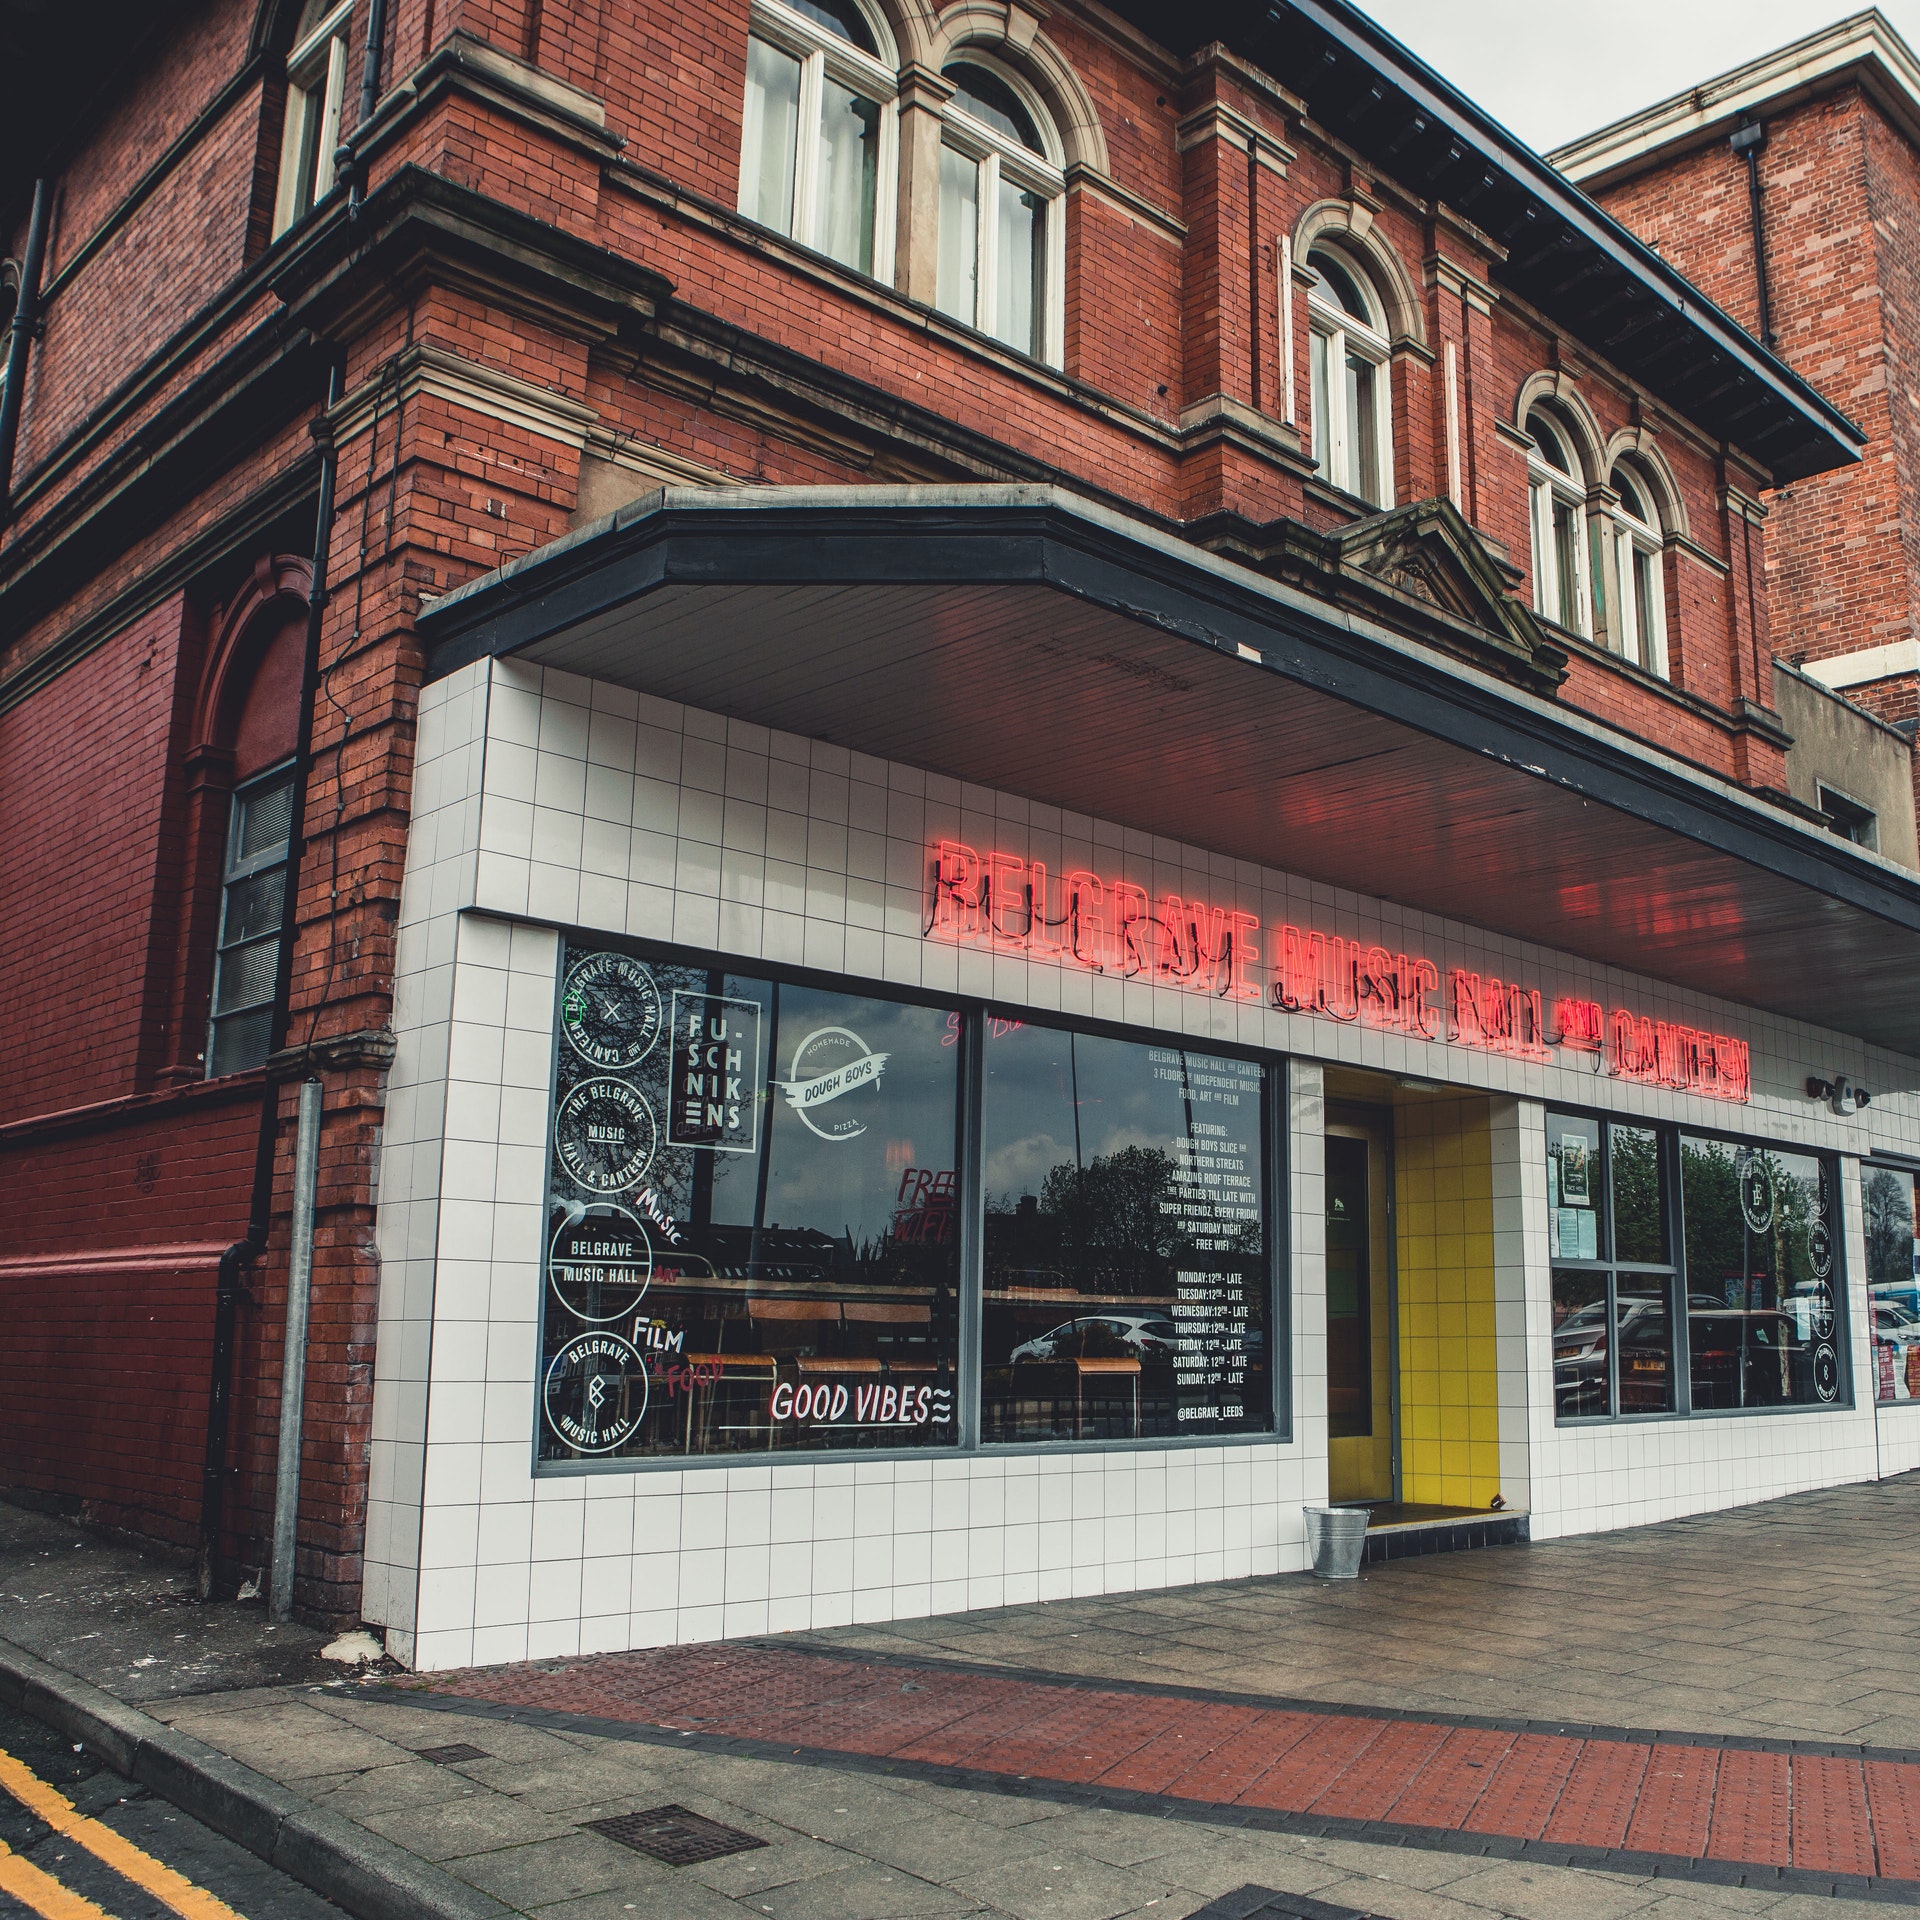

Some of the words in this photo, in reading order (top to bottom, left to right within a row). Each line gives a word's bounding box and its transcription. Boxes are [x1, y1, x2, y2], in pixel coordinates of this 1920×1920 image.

[938, 840, 1261, 998] BELGRAVE
[1282, 925, 1440, 1040] MUSIC
[1456, 969, 1553, 1062] HALL
[1563, 997, 1603, 1041] AND
[1615, 1009, 1751, 1101] CANTEEN
[617, 961, 653, 1000] MUSIC
[640, 1005, 657, 1038] HALL
[569, 1020, 619, 1063] CANTEEN
[628, 1043, 641, 1057] AND
[807, 1038, 851, 1057] HOMEMADE
[1148, 1050, 1184, 1066] BELGRAVE
[1184, 1056, 1209, 1070] MUSIC
[1210, 1059, 1227, 1073] HALL
[1237, 1063, 1266, 1079] CANTEEN
[804, 1075, 841, 1102] DOUGH
[845, 1060, 872, 1084] BOYS
[1153, 1067, 1158, 1079] 3
[1160, 1068, 1186, 1083] FLOORS
[1193, 1073, 1238, 1090] INDEPENDENT
[567, 1092, 589, 1116] THE
[590, 1084, 646, 1122] BELGRAVE
[1199, 1090, 1212, 1103] ART
[1223, 1093, 1239, 1106] FILM
[588, 1125, 625, 1140] MUSIC
[833, 1119, 860, 1132] PIZZA
[1190, 1122, 1229, 1137] FEATURING:
[1176, 1136, 1200, 1150] DOUGH
[1201, 1139, 1218, 1152] BOYS
[1219, 1141, 1238, 1154] SLICE
[563, 1142, 585, 1175] HALL
[587, 1169, 596, 1184] &
[601, 1148, 648, 1187] CANTEEN
[1179, 1154, 1215, 1168] NORTHERN
[1215, 1157, 1244, 1171] STREATS
[1172, 1169, 1203, 1183] AMAZING
[1204, 1172, 1222, 1185] ROOF
[1222, 1174, 1251, 1187] TERRACE
[1178, 1187, 1207, 1201] PARTIES
[1208, 1189, 1221, 1201] TILL
[1222, 1190, 1238, 1203] LATE
[1239, 1191, 1256, 1204] WITH
[1159, 1202, 1182, 1215] SUPER
[1214, 1206, 1235, 1219] EVERY
[1236, 1208, 1258, 1220] FRIDAY
[1187, 1221, 1221, 1235] SATURDAY
[1222, 1223, 1242, 1235] NIGHT
[571, 1241, 633, 1257] BELGRAVE
[1196, 1238, 1213, 1251] FREE
[1214, 1240, 1229, 1251] WIFI
[563, 1267, 604, 1282] MUSIC
[609, 1268, 638, 1283] HALL
[653, 1264, 680, 1283] ART
[1226, 1273, 1243, 1284] LATE
[1227, 1289, 1243, 1301] LATE
[1233, 1306, 1249, 1317] LATE
[1230, 1322, 1246, 1334] LATE
[1178, 1339, 1204, 1350] FRIDAY:
[1226, 1338, 1242, 1350] LATE
[568, 1340, 630, 1366] BELGRAVE
[1172, 1356, 1210, 1368] SATURDAY:
[1231, 1355, 1248, 1367] LATE
[667, 1356, 724, 1398] FOOD
[1176, 1372, 1206, 1385] SUNDAY:
[1228, 1372, 1244, 1384] LATE
[769, 1382, 849, 1421] GOOD
[855, 1383, 932, 1424] VIBES
[1177, 1405, 1244, 1421] @BELGRAVE_LEEDS
[560, 1415, 598, 1444] MUSIC
[602, 1417, 631, 1443] HALL
